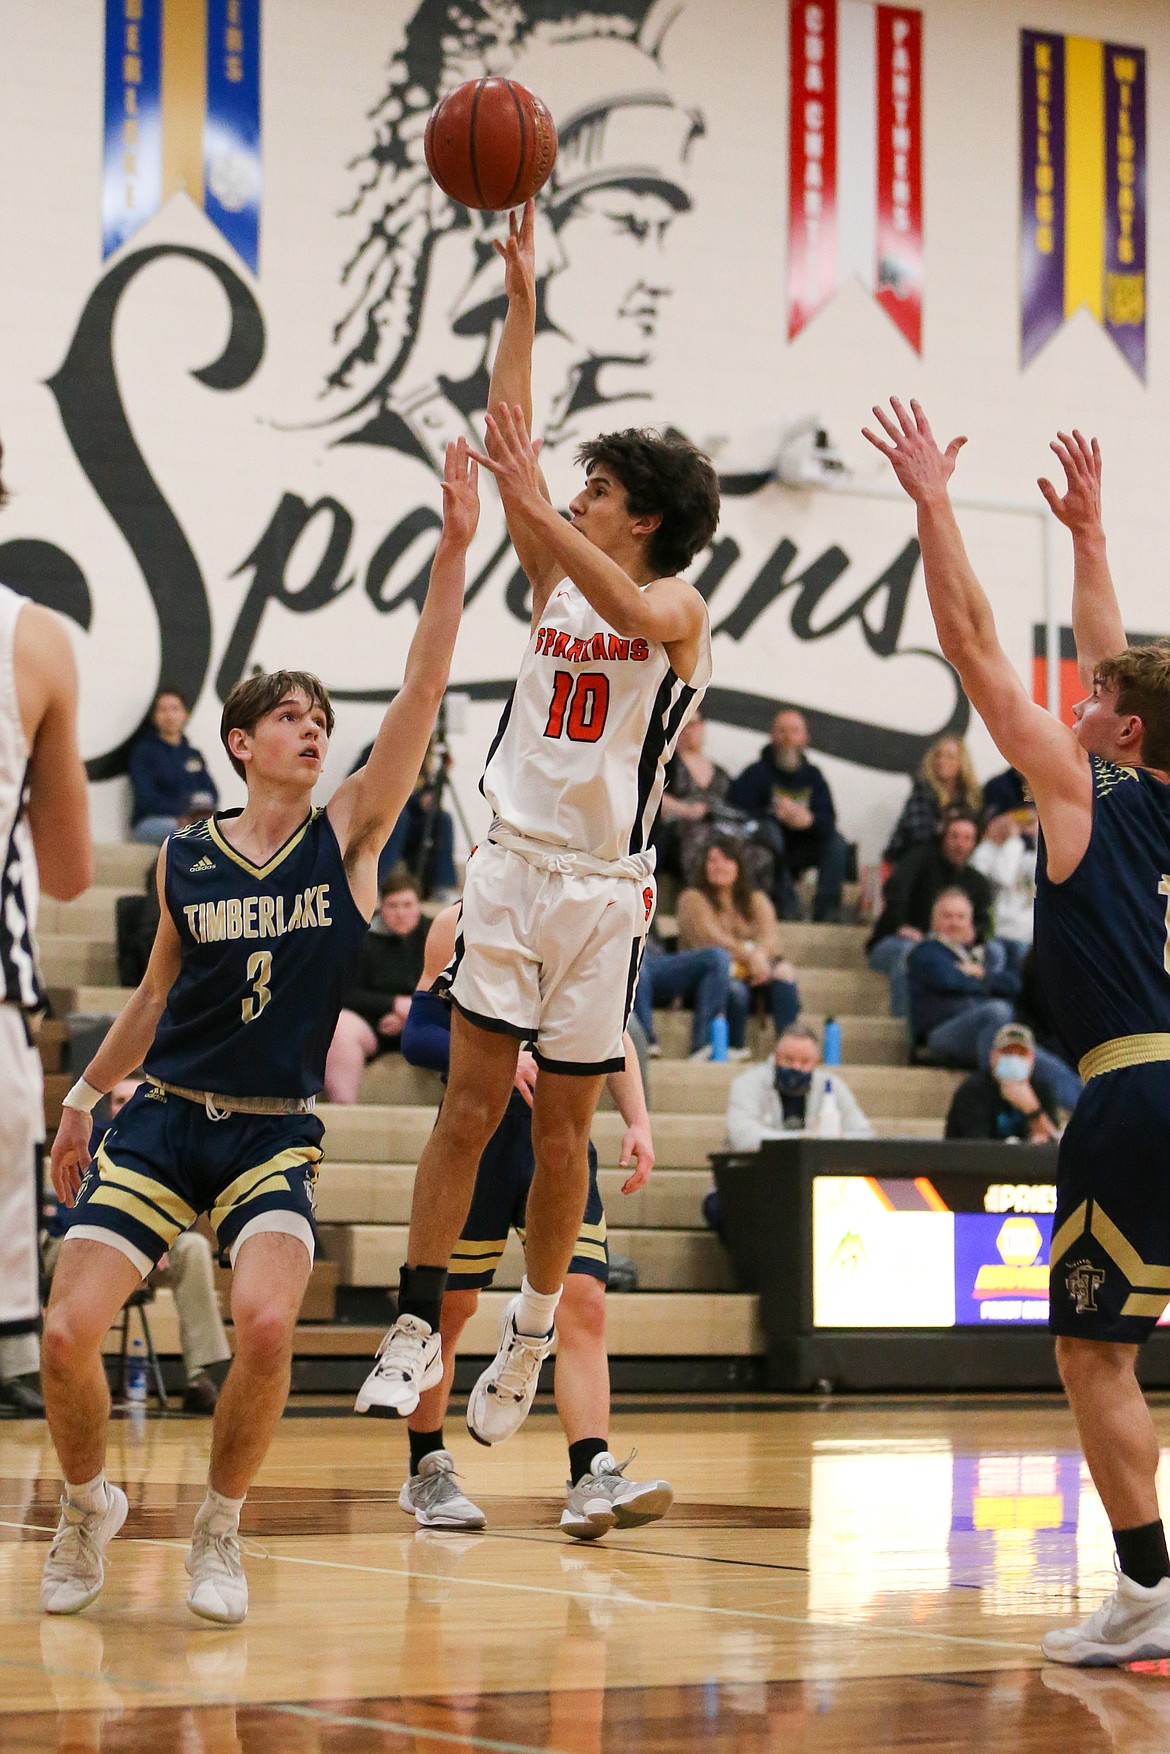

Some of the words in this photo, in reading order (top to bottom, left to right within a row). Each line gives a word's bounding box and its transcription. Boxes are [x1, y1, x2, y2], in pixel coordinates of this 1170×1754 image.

[1113, 56, 1137, 264] WILDCATS
[535, 627, 650, 663] SPARTANS
[542, 669, 611, 744] 10
[183, 883, 333, 944] TIMBERLAKE
[241, 949, 274, 1025] 3
